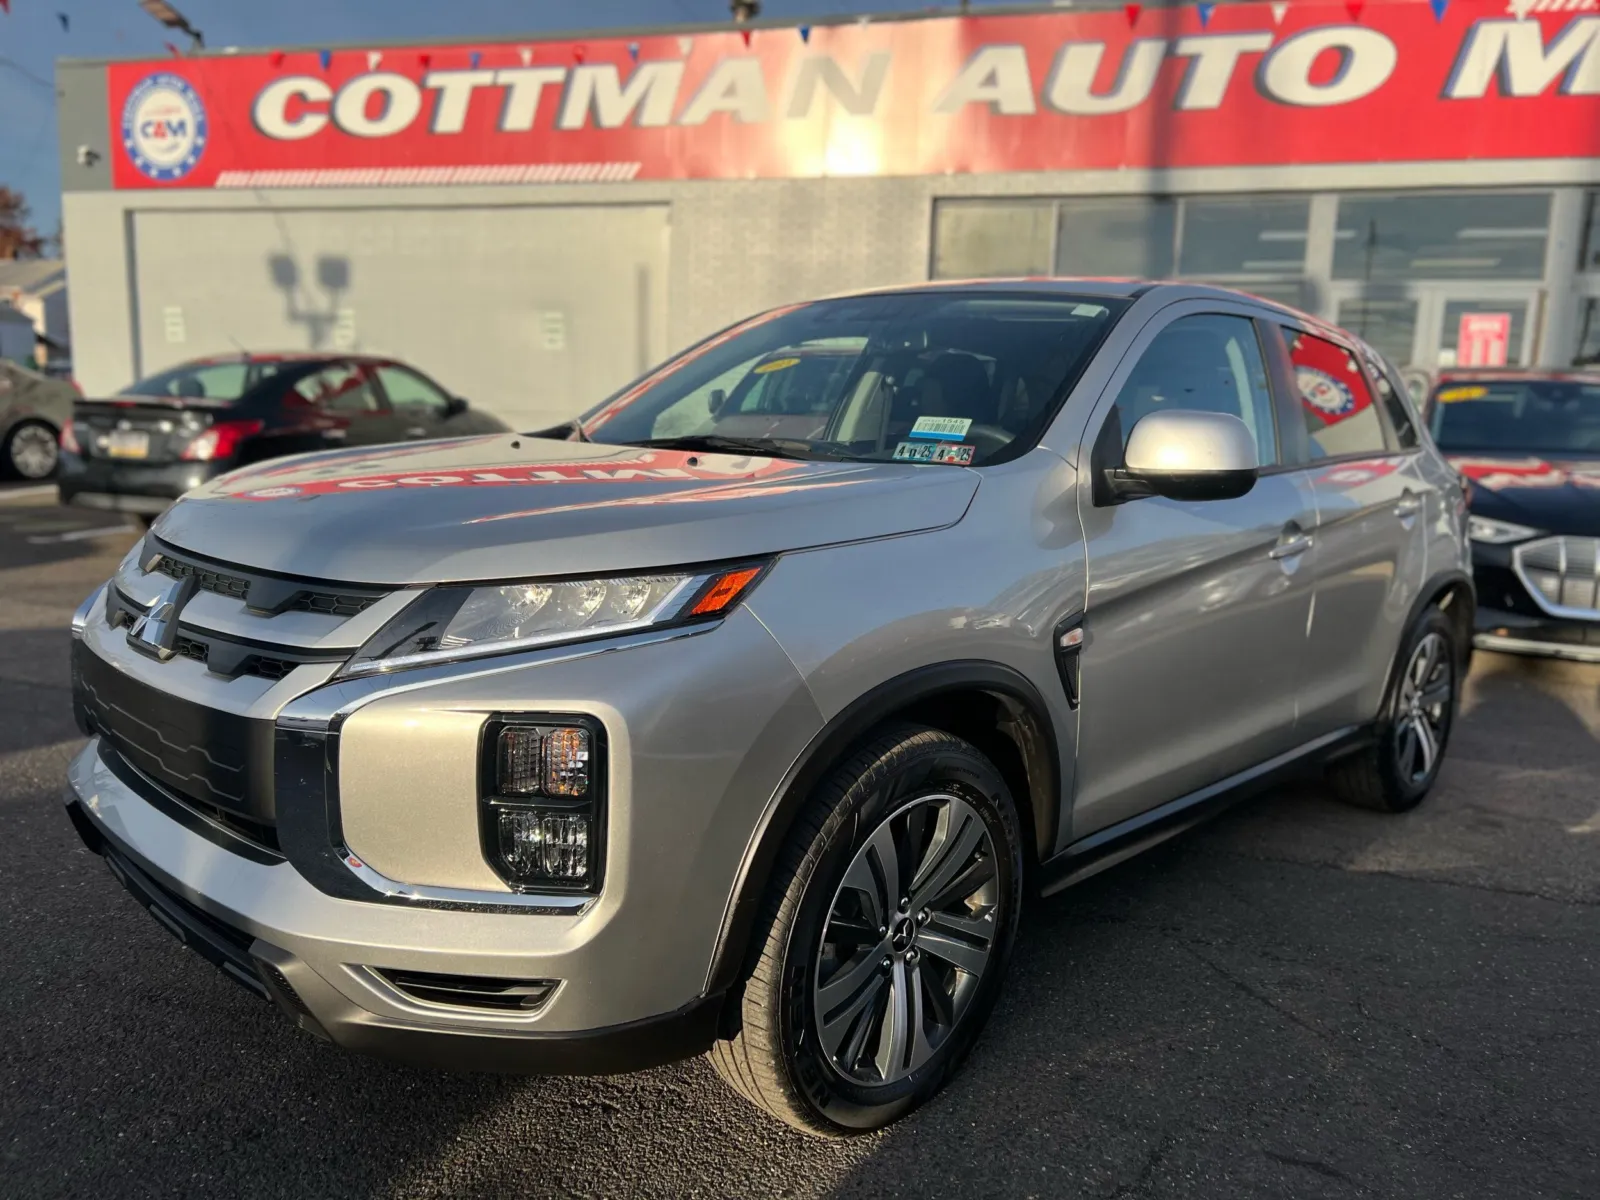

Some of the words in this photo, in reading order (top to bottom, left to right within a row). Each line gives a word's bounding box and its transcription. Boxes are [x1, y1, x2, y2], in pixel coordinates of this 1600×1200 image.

[252, 53, 891, 139] COTTMAN
[935, 24, 1397, 115] AUTO
[1441, 14, 1600, 99] M
[898, 445, 906, 457] 4
[920, 445, 933, 458] 25
[937, 449, 946, 461] 4
[960, 448, 972, 461] 25
